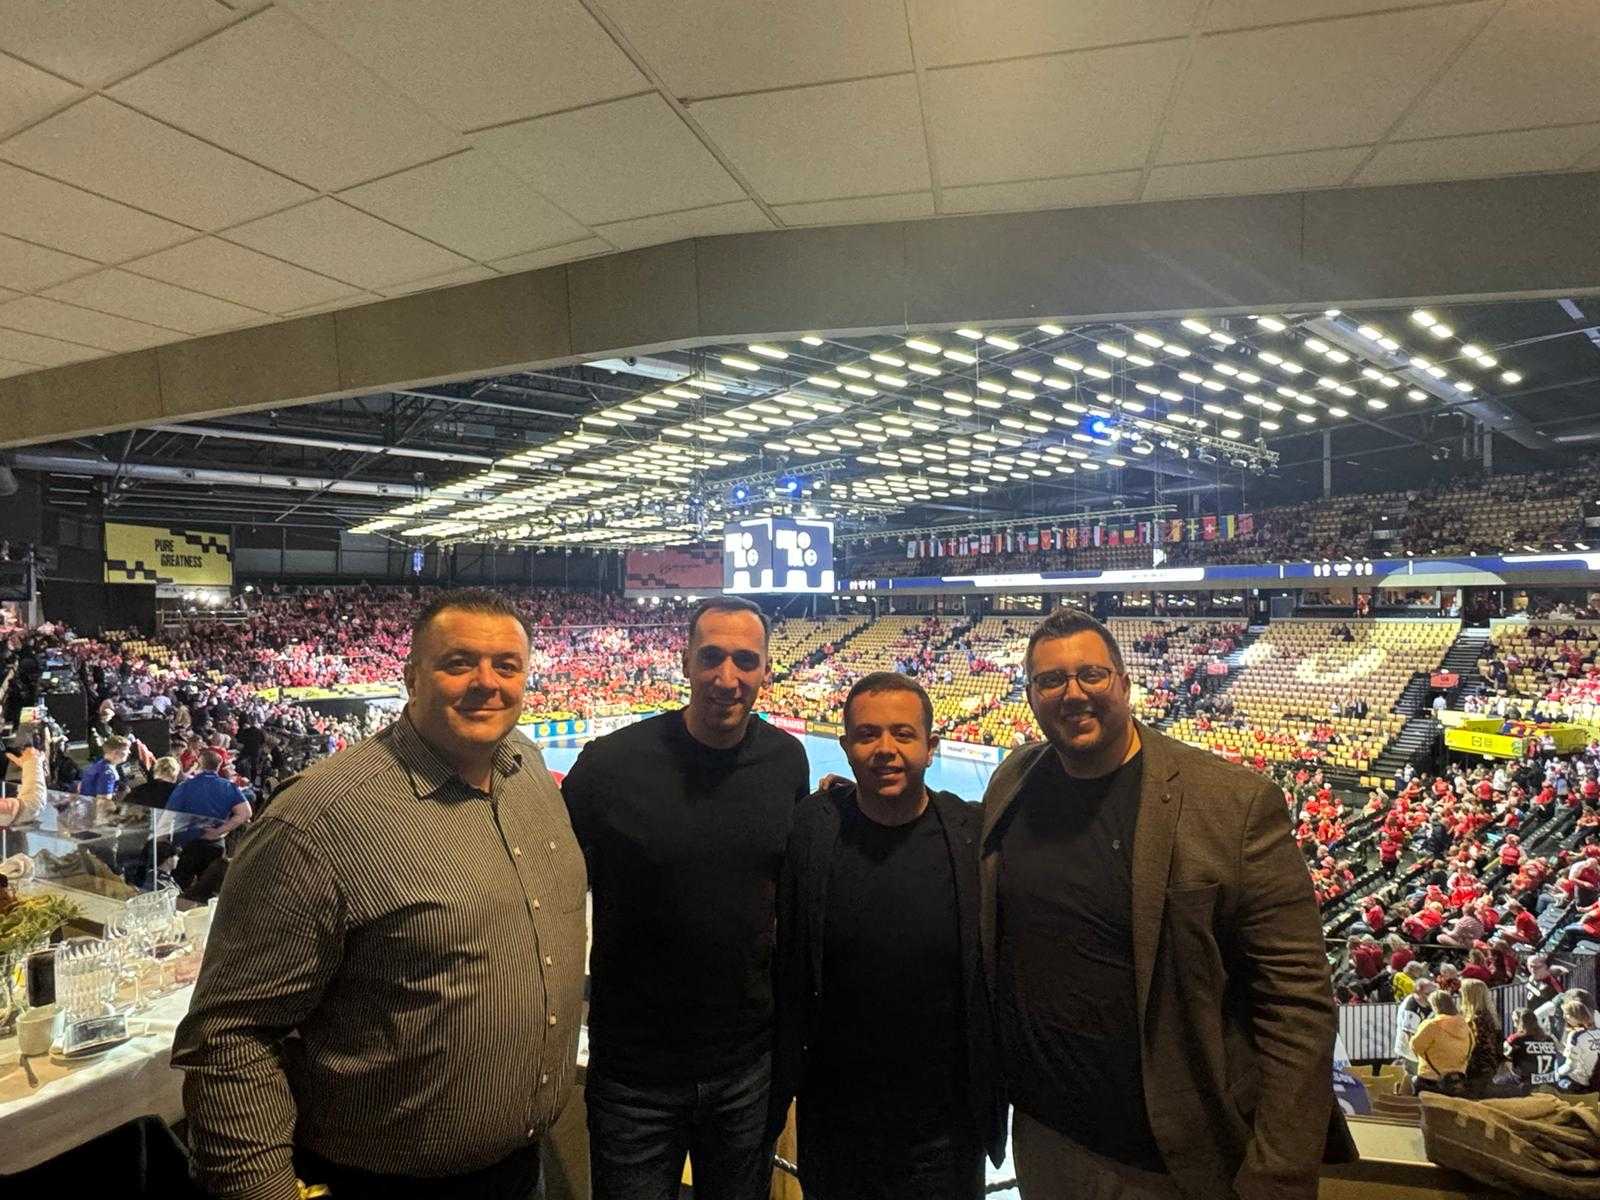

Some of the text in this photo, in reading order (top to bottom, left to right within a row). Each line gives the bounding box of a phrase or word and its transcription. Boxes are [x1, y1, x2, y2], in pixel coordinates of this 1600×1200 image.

[155, 538, 174, 552] PURE
[160, 554, 202, 568] GREATNESS
[1536, 1055, 1553, 1074] 17
